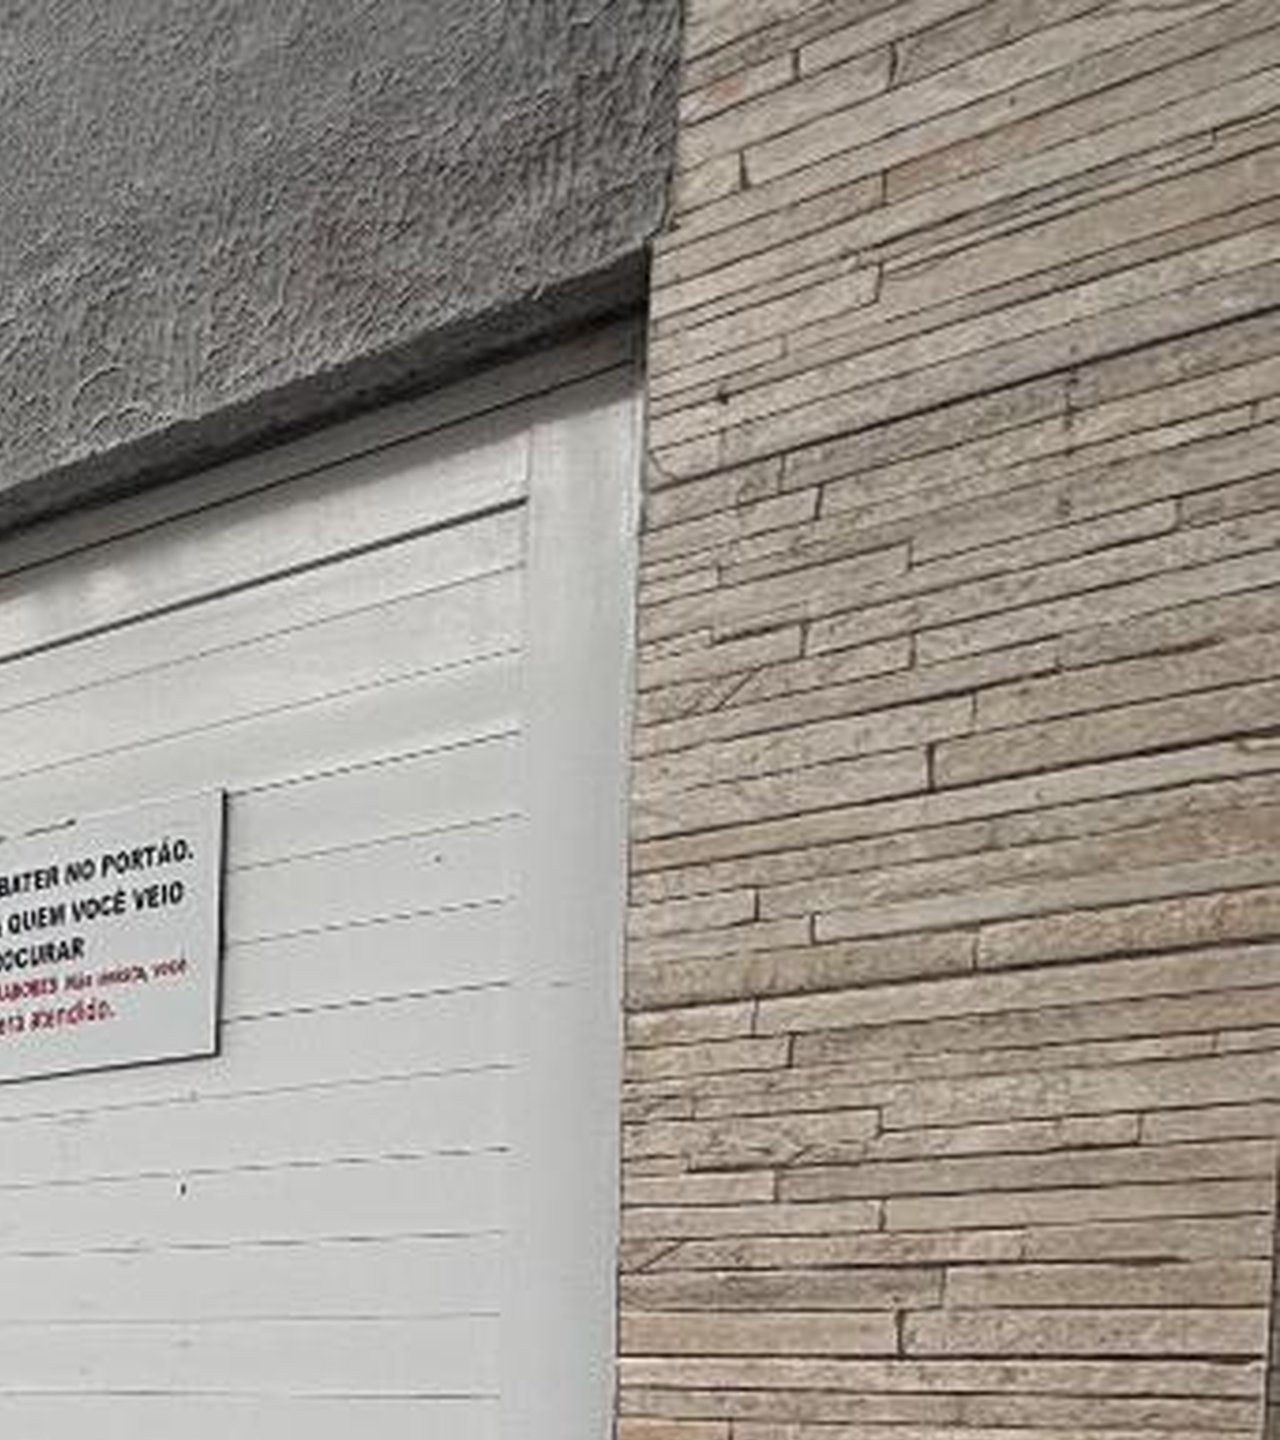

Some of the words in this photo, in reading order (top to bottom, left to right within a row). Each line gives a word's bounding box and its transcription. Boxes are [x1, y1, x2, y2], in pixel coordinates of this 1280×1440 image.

[65, 858, 95, 885] NO
[102, 836, 194, 878] PORTÃO.
[8, 903, 66, 934] QUEM
[72, 886, 126, 922] VOCÊ
[132, 881, 184, 910] VEIO
